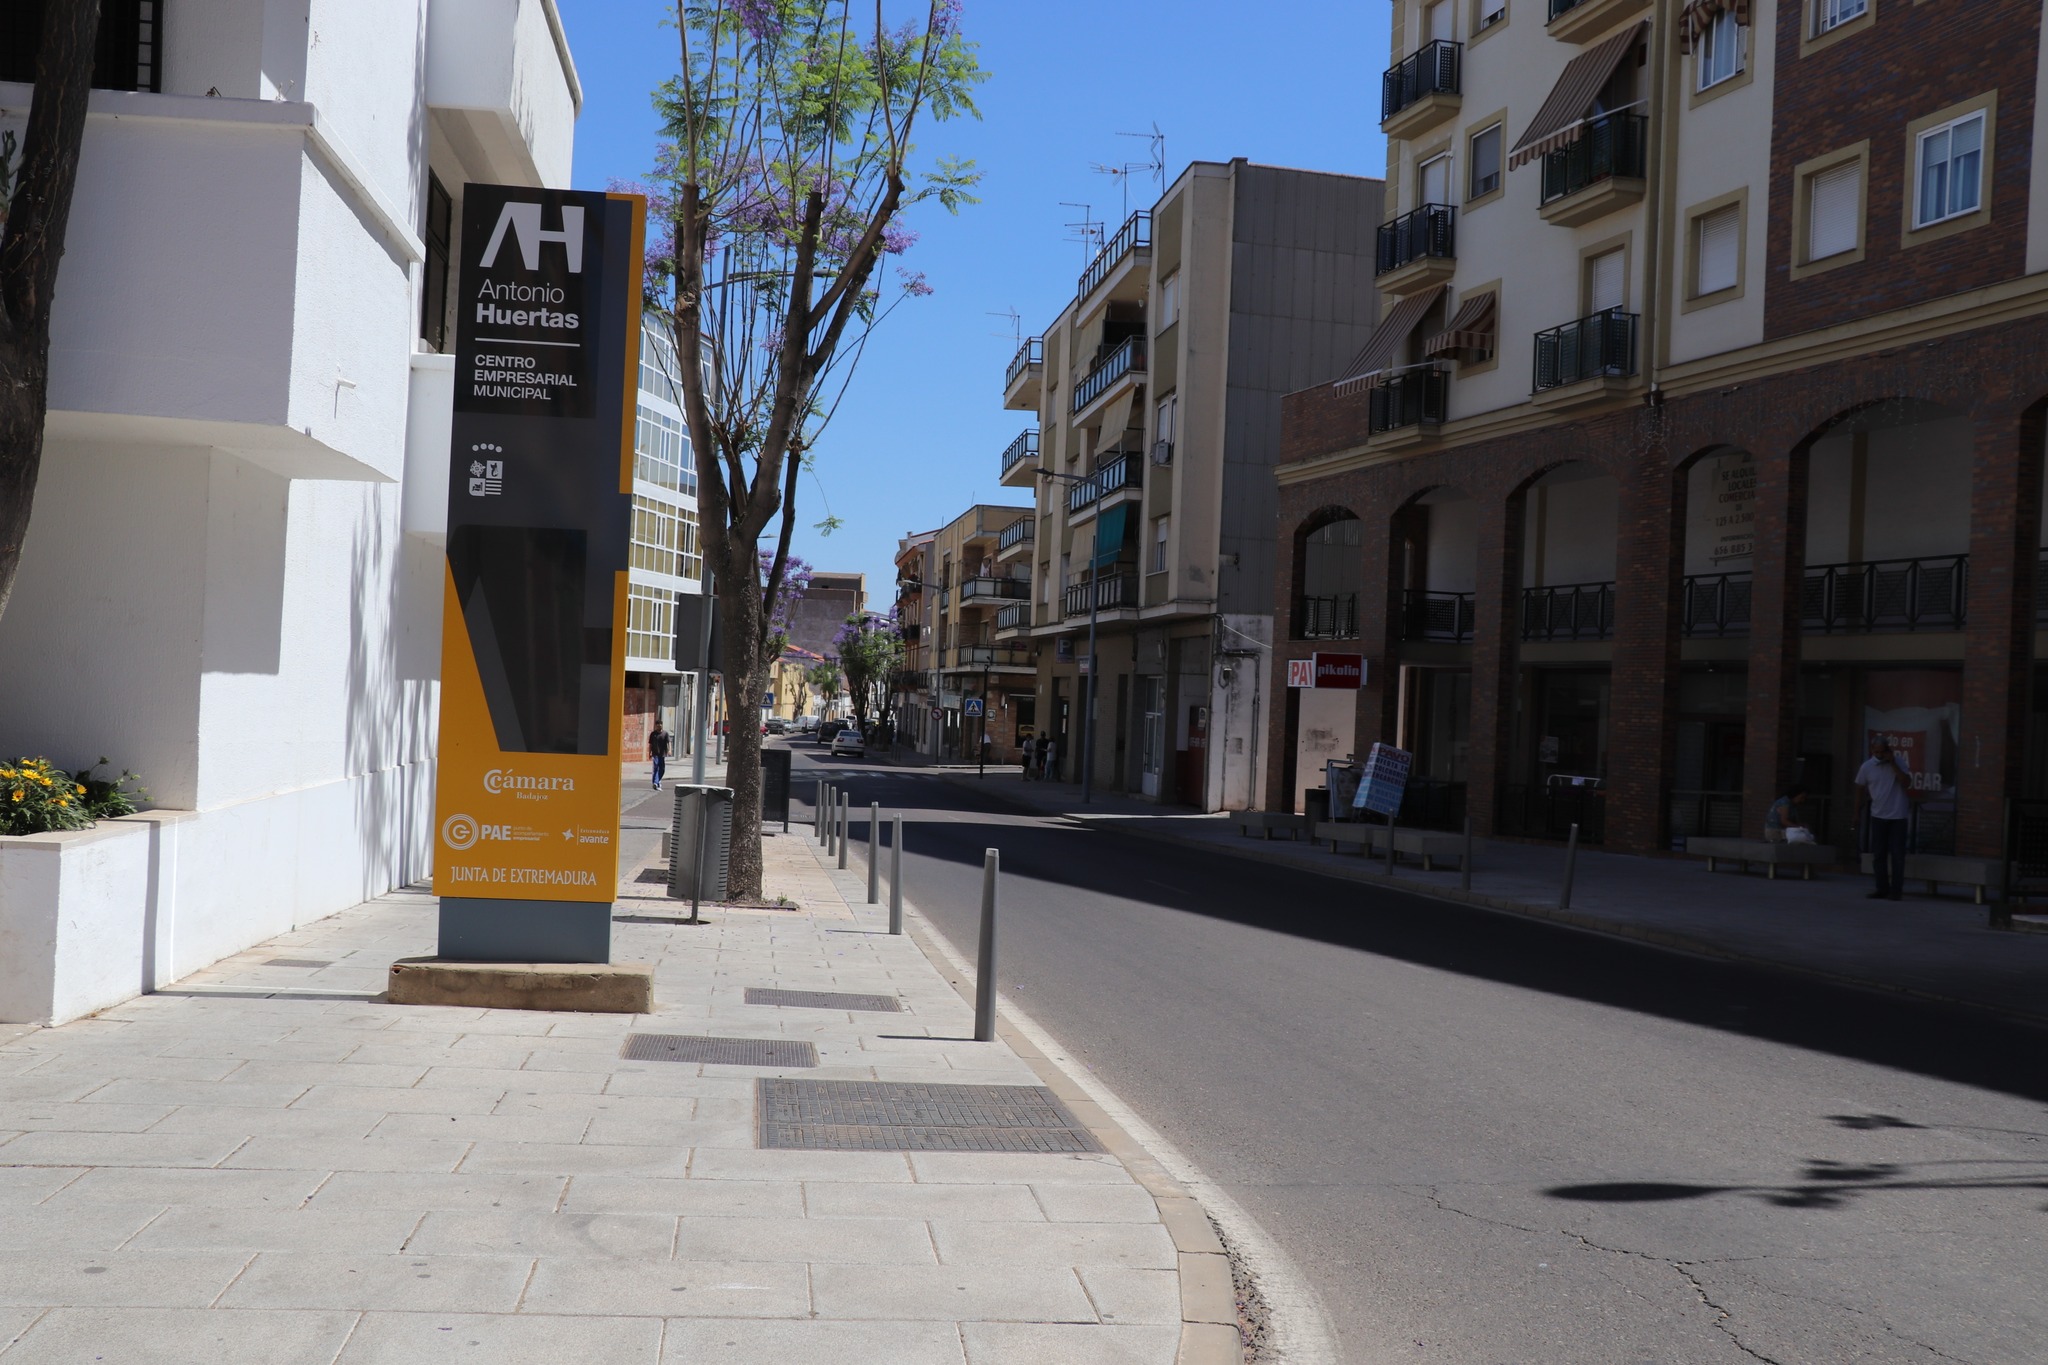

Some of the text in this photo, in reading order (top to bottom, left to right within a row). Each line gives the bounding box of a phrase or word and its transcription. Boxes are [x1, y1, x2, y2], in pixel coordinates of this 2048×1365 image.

[477, 278, 565, 304] Antonio
[475, 302, 579, 329] Huertas
[474, 354, 536, 369] CENTRO
[474, 369, 577, 386] EMPRESARIAL
[473, 384, 551, 400] MUNICIPAL
[1722, 470, 1729, 480] SE
[1059, 639, 1072, 654] P
[1317, 663, 1360, 678] pikolin
[1901, 736, 1914, 748] en
[1378, 747, 1410, 764] PAVO
[483, 768, 575, 795] Cámara
[516, 791, 549, 802] Badajoz
[481, 824, 512, 841] PAE
[579, 835, 609, 844] avante
[450, 866, 597, 886] JUNTA DE EXTREMADURA
